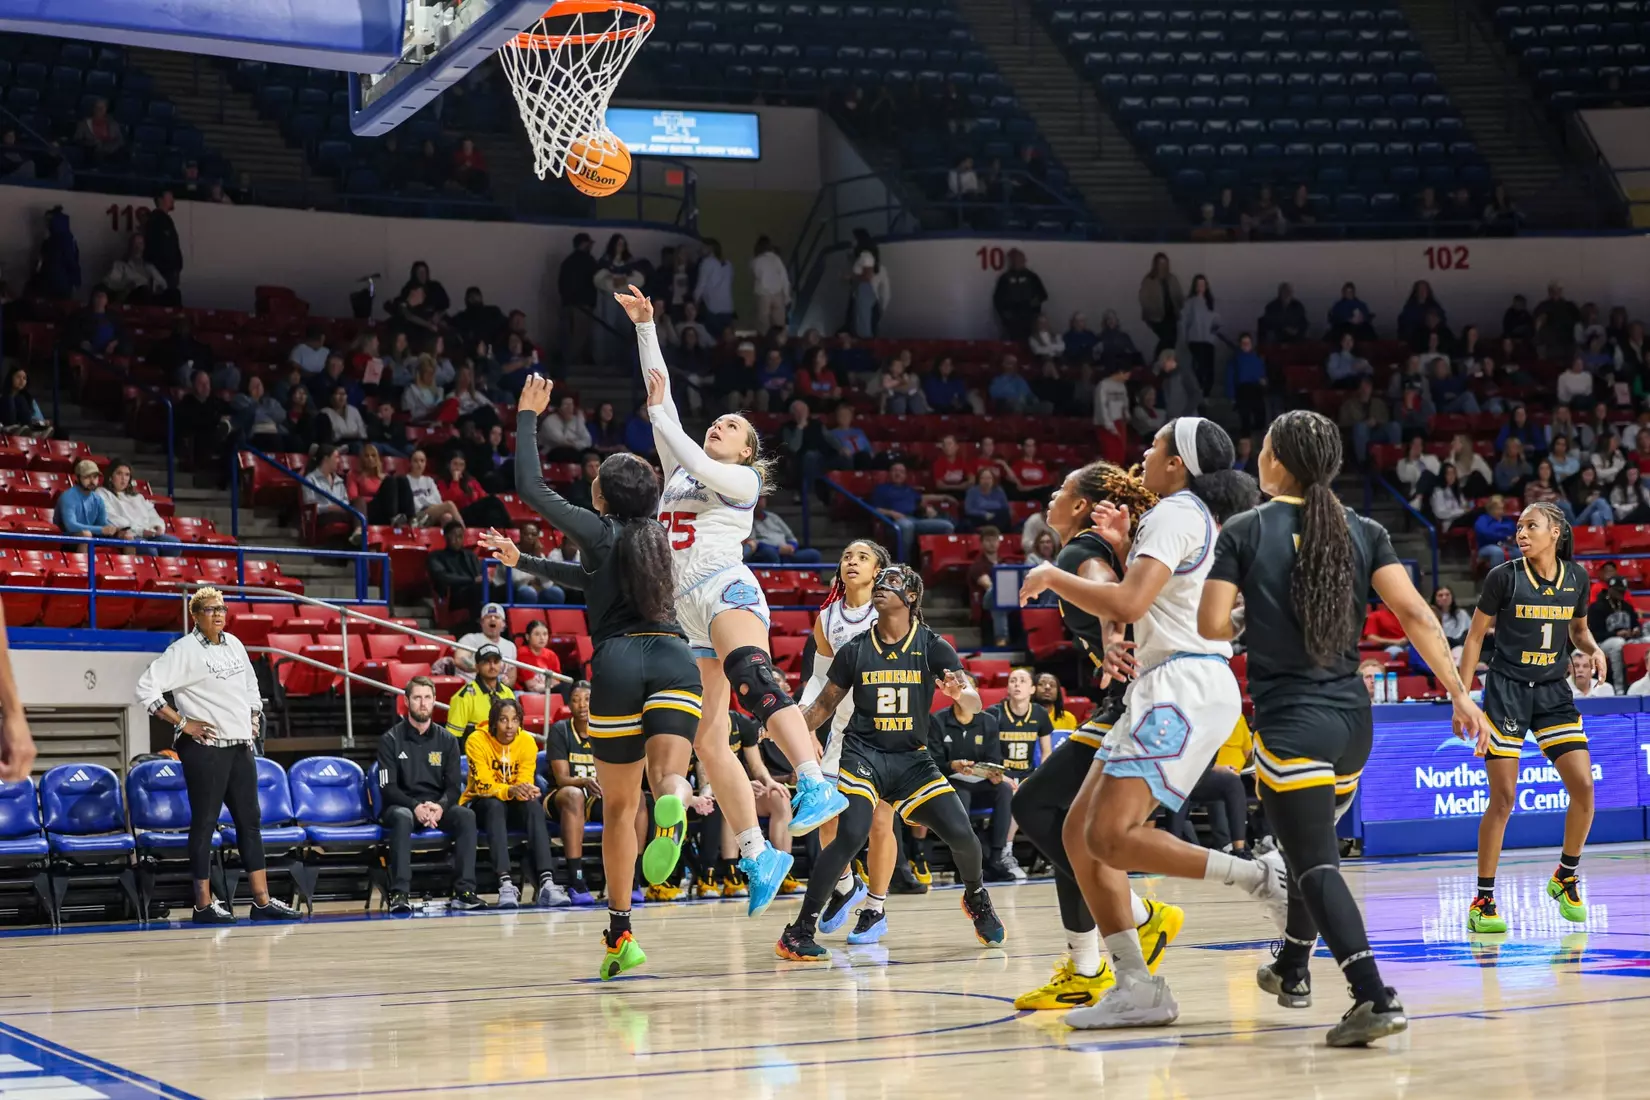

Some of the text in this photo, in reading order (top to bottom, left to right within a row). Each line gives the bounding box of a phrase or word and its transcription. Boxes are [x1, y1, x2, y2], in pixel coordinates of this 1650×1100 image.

[976, 247, 1008, 271] 10
[1423, 246, 1469, 270] 102
[1515, 604, 1574, 620] KENNESAW
[1540, 622, 1553, 649] 1
[861, 670, 921, 685] KENNESAW
[876, 687, 908, 713] 21
[873, 717, 913, 731] STATE
[1008, 742, 1028, 760] 12
[1415, 759, 1603, 789] Northe ouisa
[1434, 788, 1570, 815] Medi Cent
